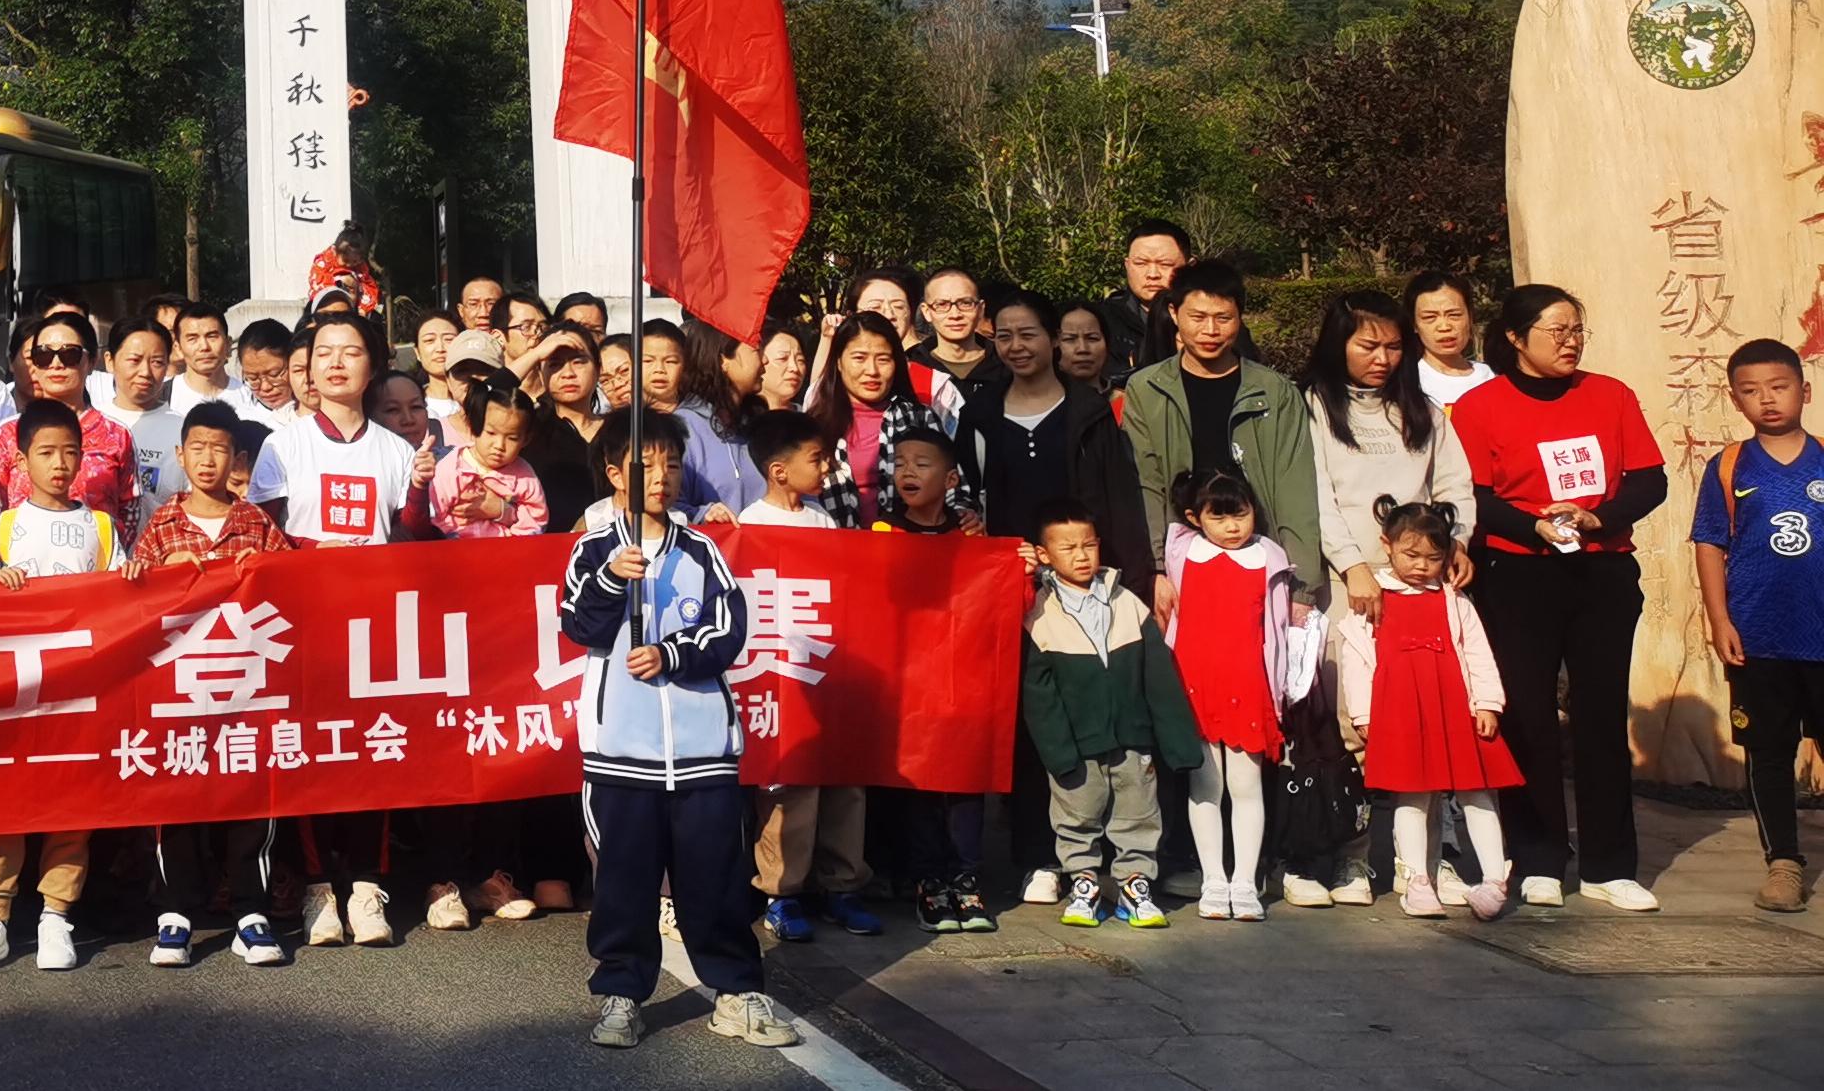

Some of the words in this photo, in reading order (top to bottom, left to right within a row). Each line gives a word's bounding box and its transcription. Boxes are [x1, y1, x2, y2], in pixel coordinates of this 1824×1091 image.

[1552, 446, 1592, 467] 长城
[329, 480, 367, 502] 长城
[1558, 469, 1597, 491] 信息
[328, 505, 367, 527] 信息
[1770, 511, 1812, 557] 3
